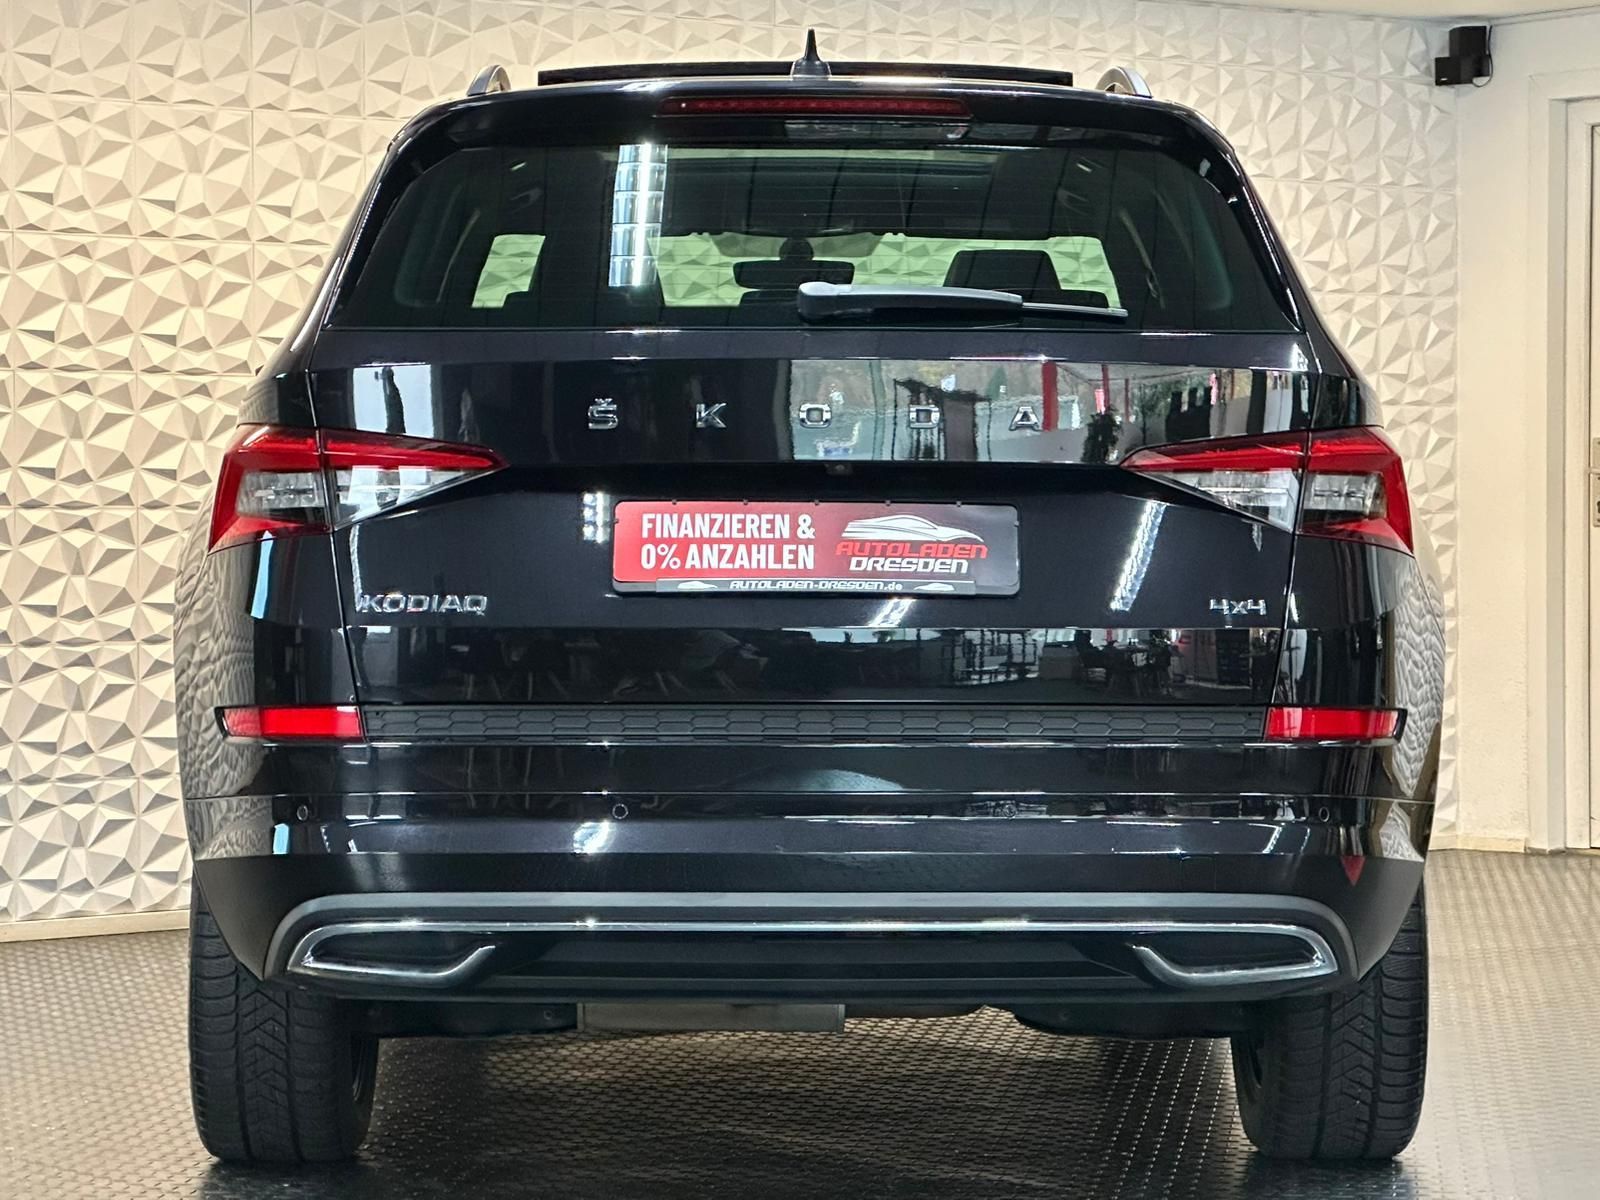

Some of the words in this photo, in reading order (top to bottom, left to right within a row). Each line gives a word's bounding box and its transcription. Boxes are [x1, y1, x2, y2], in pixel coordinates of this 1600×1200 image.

[641, 513, 790, 539] FINANZIEREN
[796, 513, 816, 539] &
[640, 543, 681, 569] 0%
[685, 543, 815, 569] ANZAHLEN
[836, 541, 988, 559] AUTOLADEN
[849, 557, 968, 574] DRESDEN
[360, 594, 488, 616] KODIAQ
